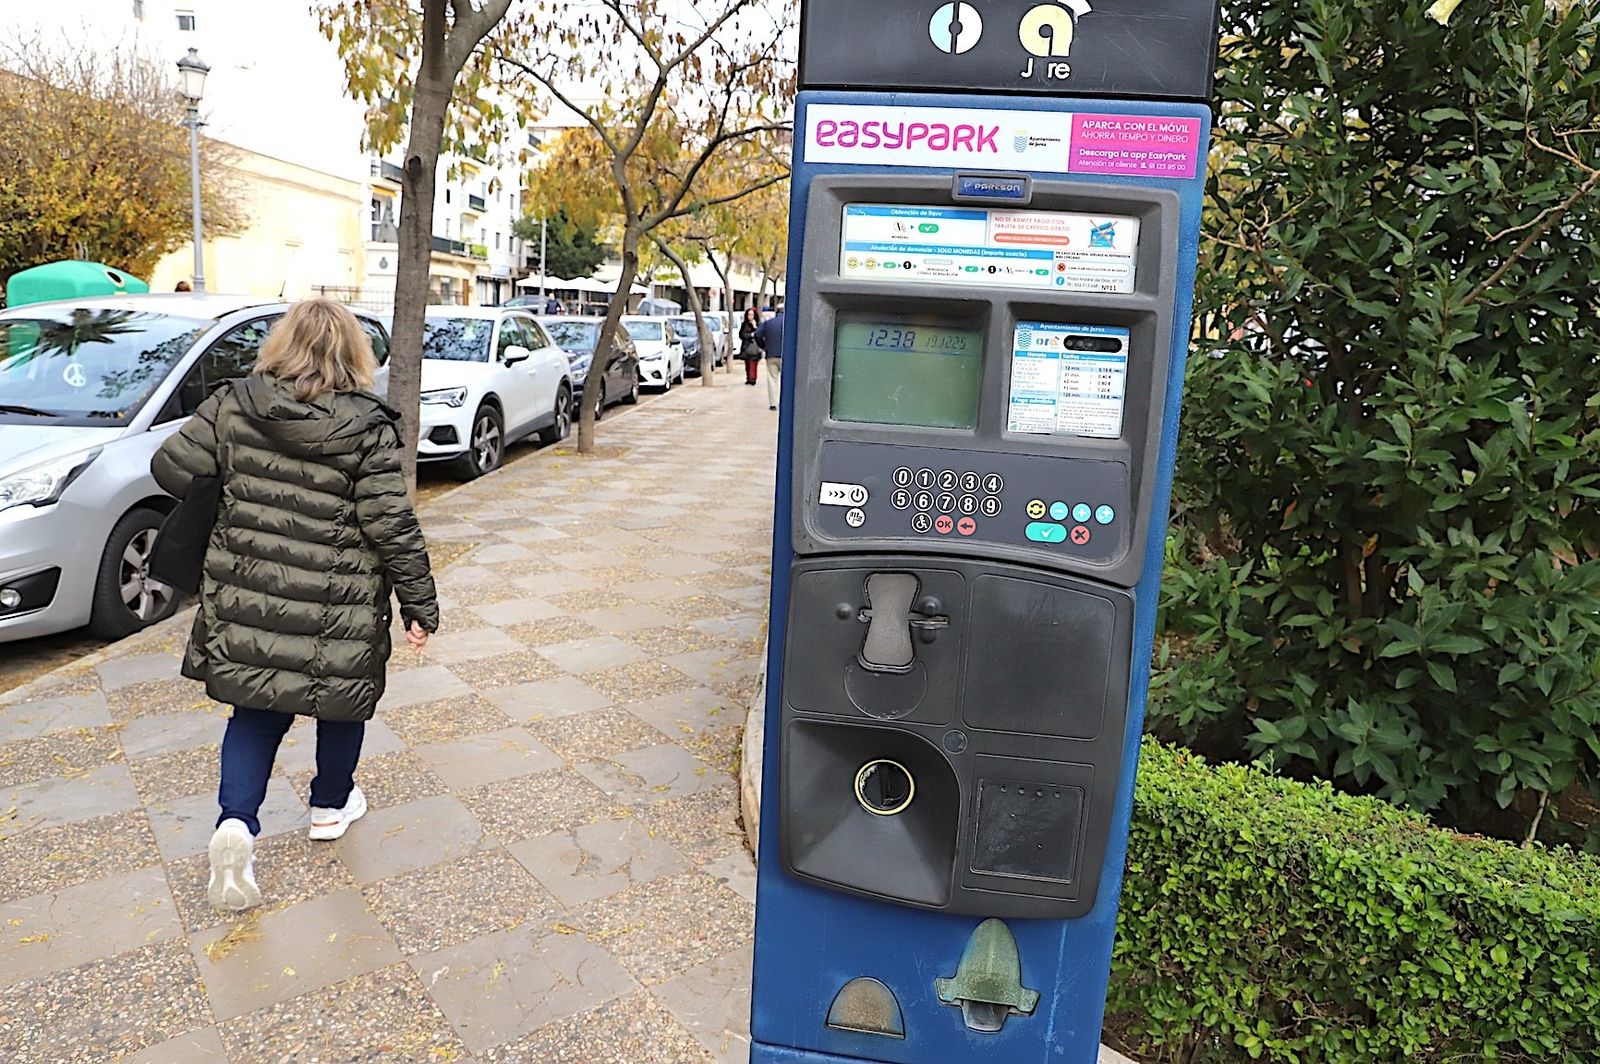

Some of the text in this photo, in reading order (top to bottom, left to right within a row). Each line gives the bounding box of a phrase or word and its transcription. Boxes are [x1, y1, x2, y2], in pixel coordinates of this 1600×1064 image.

[1081, 120, 1189, 134] APARCA CON EL MÓVIL
[1080, 131, 1116, 140] AHORRA
[1118, 132, 1148, 141] TIEMPO
[1157, 134, 1189, 143] DINERO
[1079, 149, 1187, 162] Descarga la app EasyPark
[1078, 159, 1107, 168] Atención
[1115, 161, 1138, 169] cliente
[953, 248, 981, 256] MONEDAS
[1040, 323, 1081, 332] Ayuntamiento
[898, 470, 998, 490] 0 1 2 3 4
[896, 492, 996, 513] 5 6 7 8 9
[937, 520, 952, 529] OK
